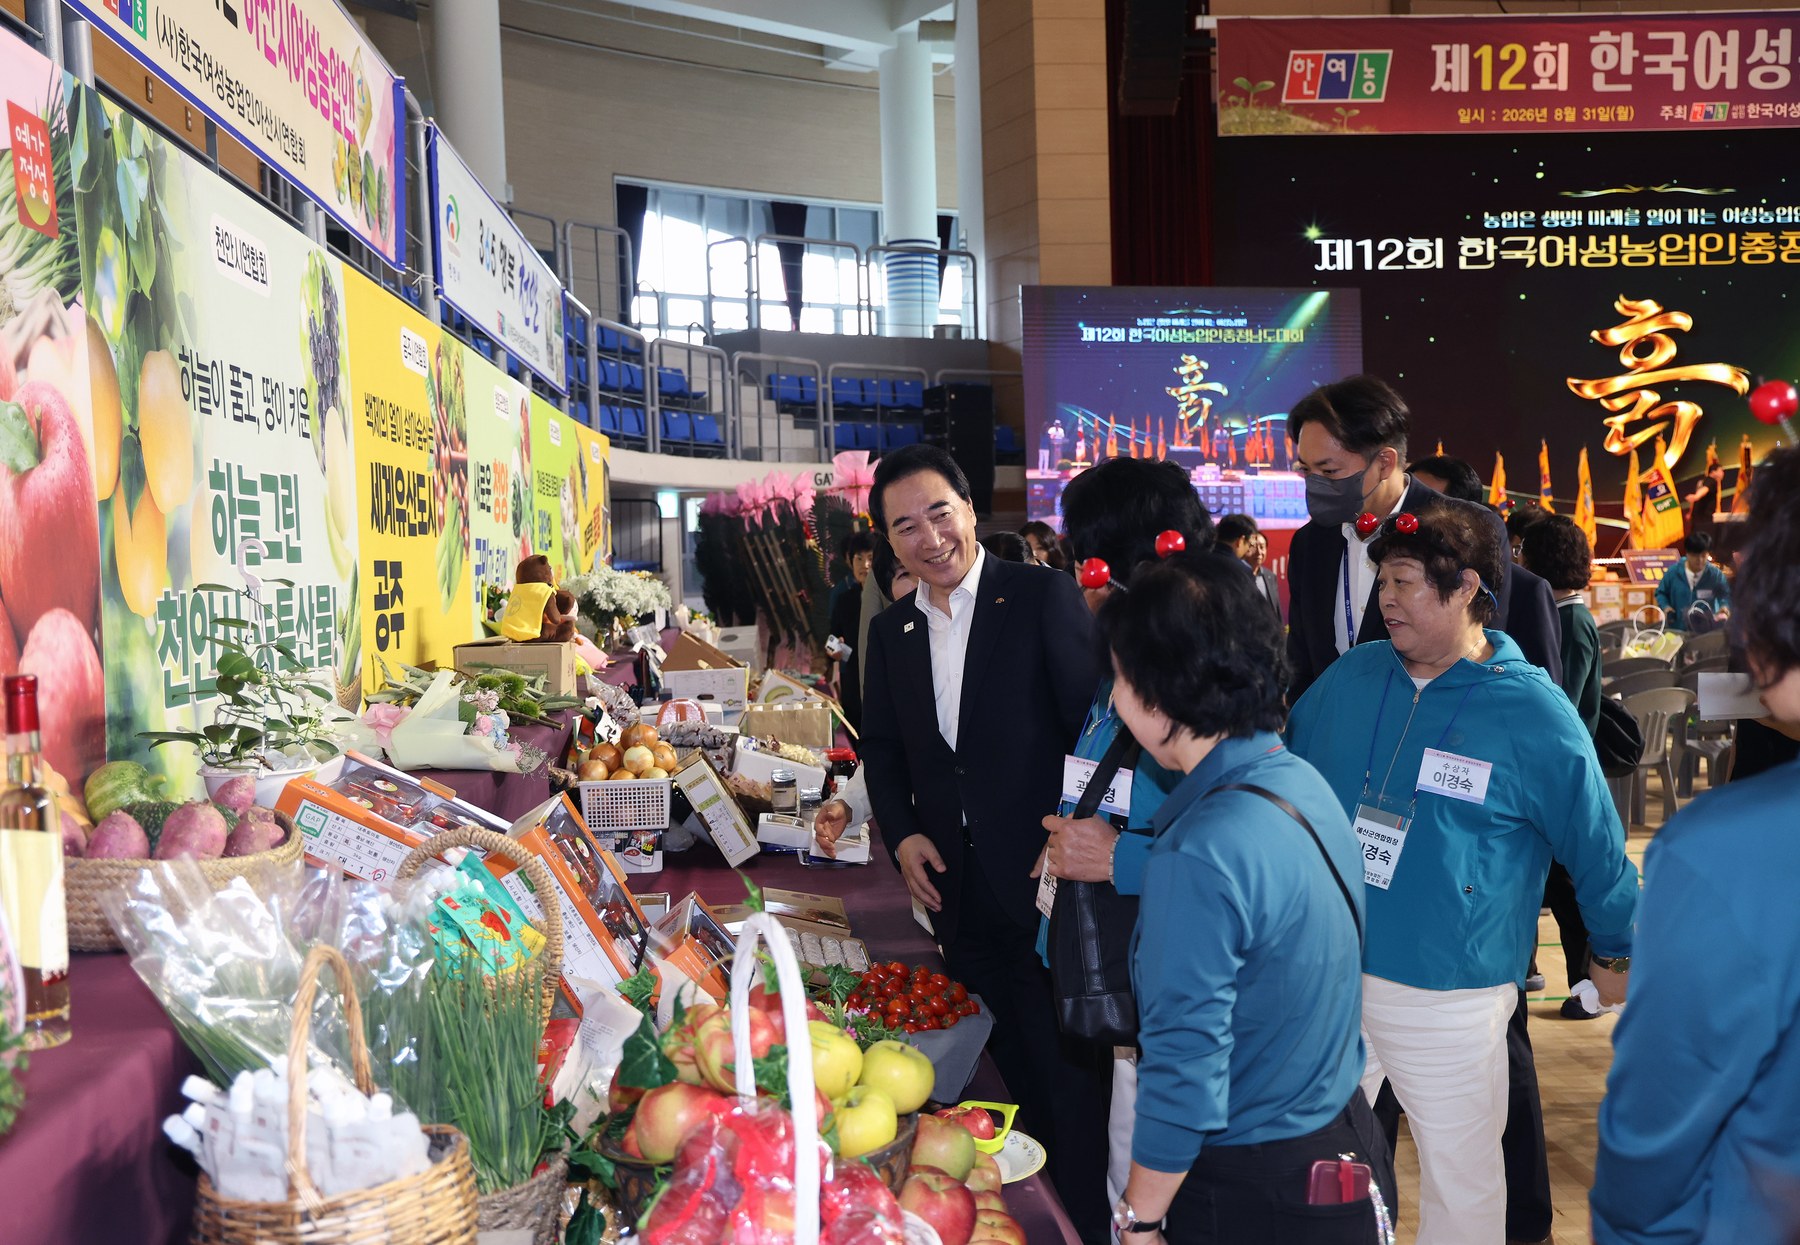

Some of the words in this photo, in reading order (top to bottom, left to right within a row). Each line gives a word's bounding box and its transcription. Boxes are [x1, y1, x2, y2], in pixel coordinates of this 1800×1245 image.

[1291, 57, 1378, 95] 한여농
[1430, 40, 1568, 93] 제12회
[1589, 28, 1800, 93] 한국여성
[155, 6, 307, 170] (사)한국여성농업인아산시연합회
[1457, 107, 1485, 124] 일시
[1502, 106, 1549, 123] 2026년
[1554, 106, 1577, 122] 8월
[1582, 105, 1635, 122] 31일(월)
[1660, 105, 1688, 121] 주최
[15, 122, 45, 157] 예가
[19, 156, 49, 205] 정성
[214, 224, 269, 287] 천안시연합회
[479, 217, 498, 278] 365
[1314, 236, 1444, 271] 제12회
[1080, 326, 1125, 343] 제12회
[178, 344, 226, 418] 하늘이
[229, 363, 261, 435] 품고,
[262, 376, 288, 435] 땅이
[289, 385, 311, 440] 키운
[814, 472, 834, 487] GA
[207, 457, 303, 566] 하늘그린
[370, 461, 438, 538] 세계유산도시
[373, 559, 405, 653] 공주
[1433, 771, 1474, 793] 이경숙
[304, 812, 320, 823] GAP
[1356, 826, 1399, 847] 예산군연합회장
[1361, 842, 1392, 866] 경숙
